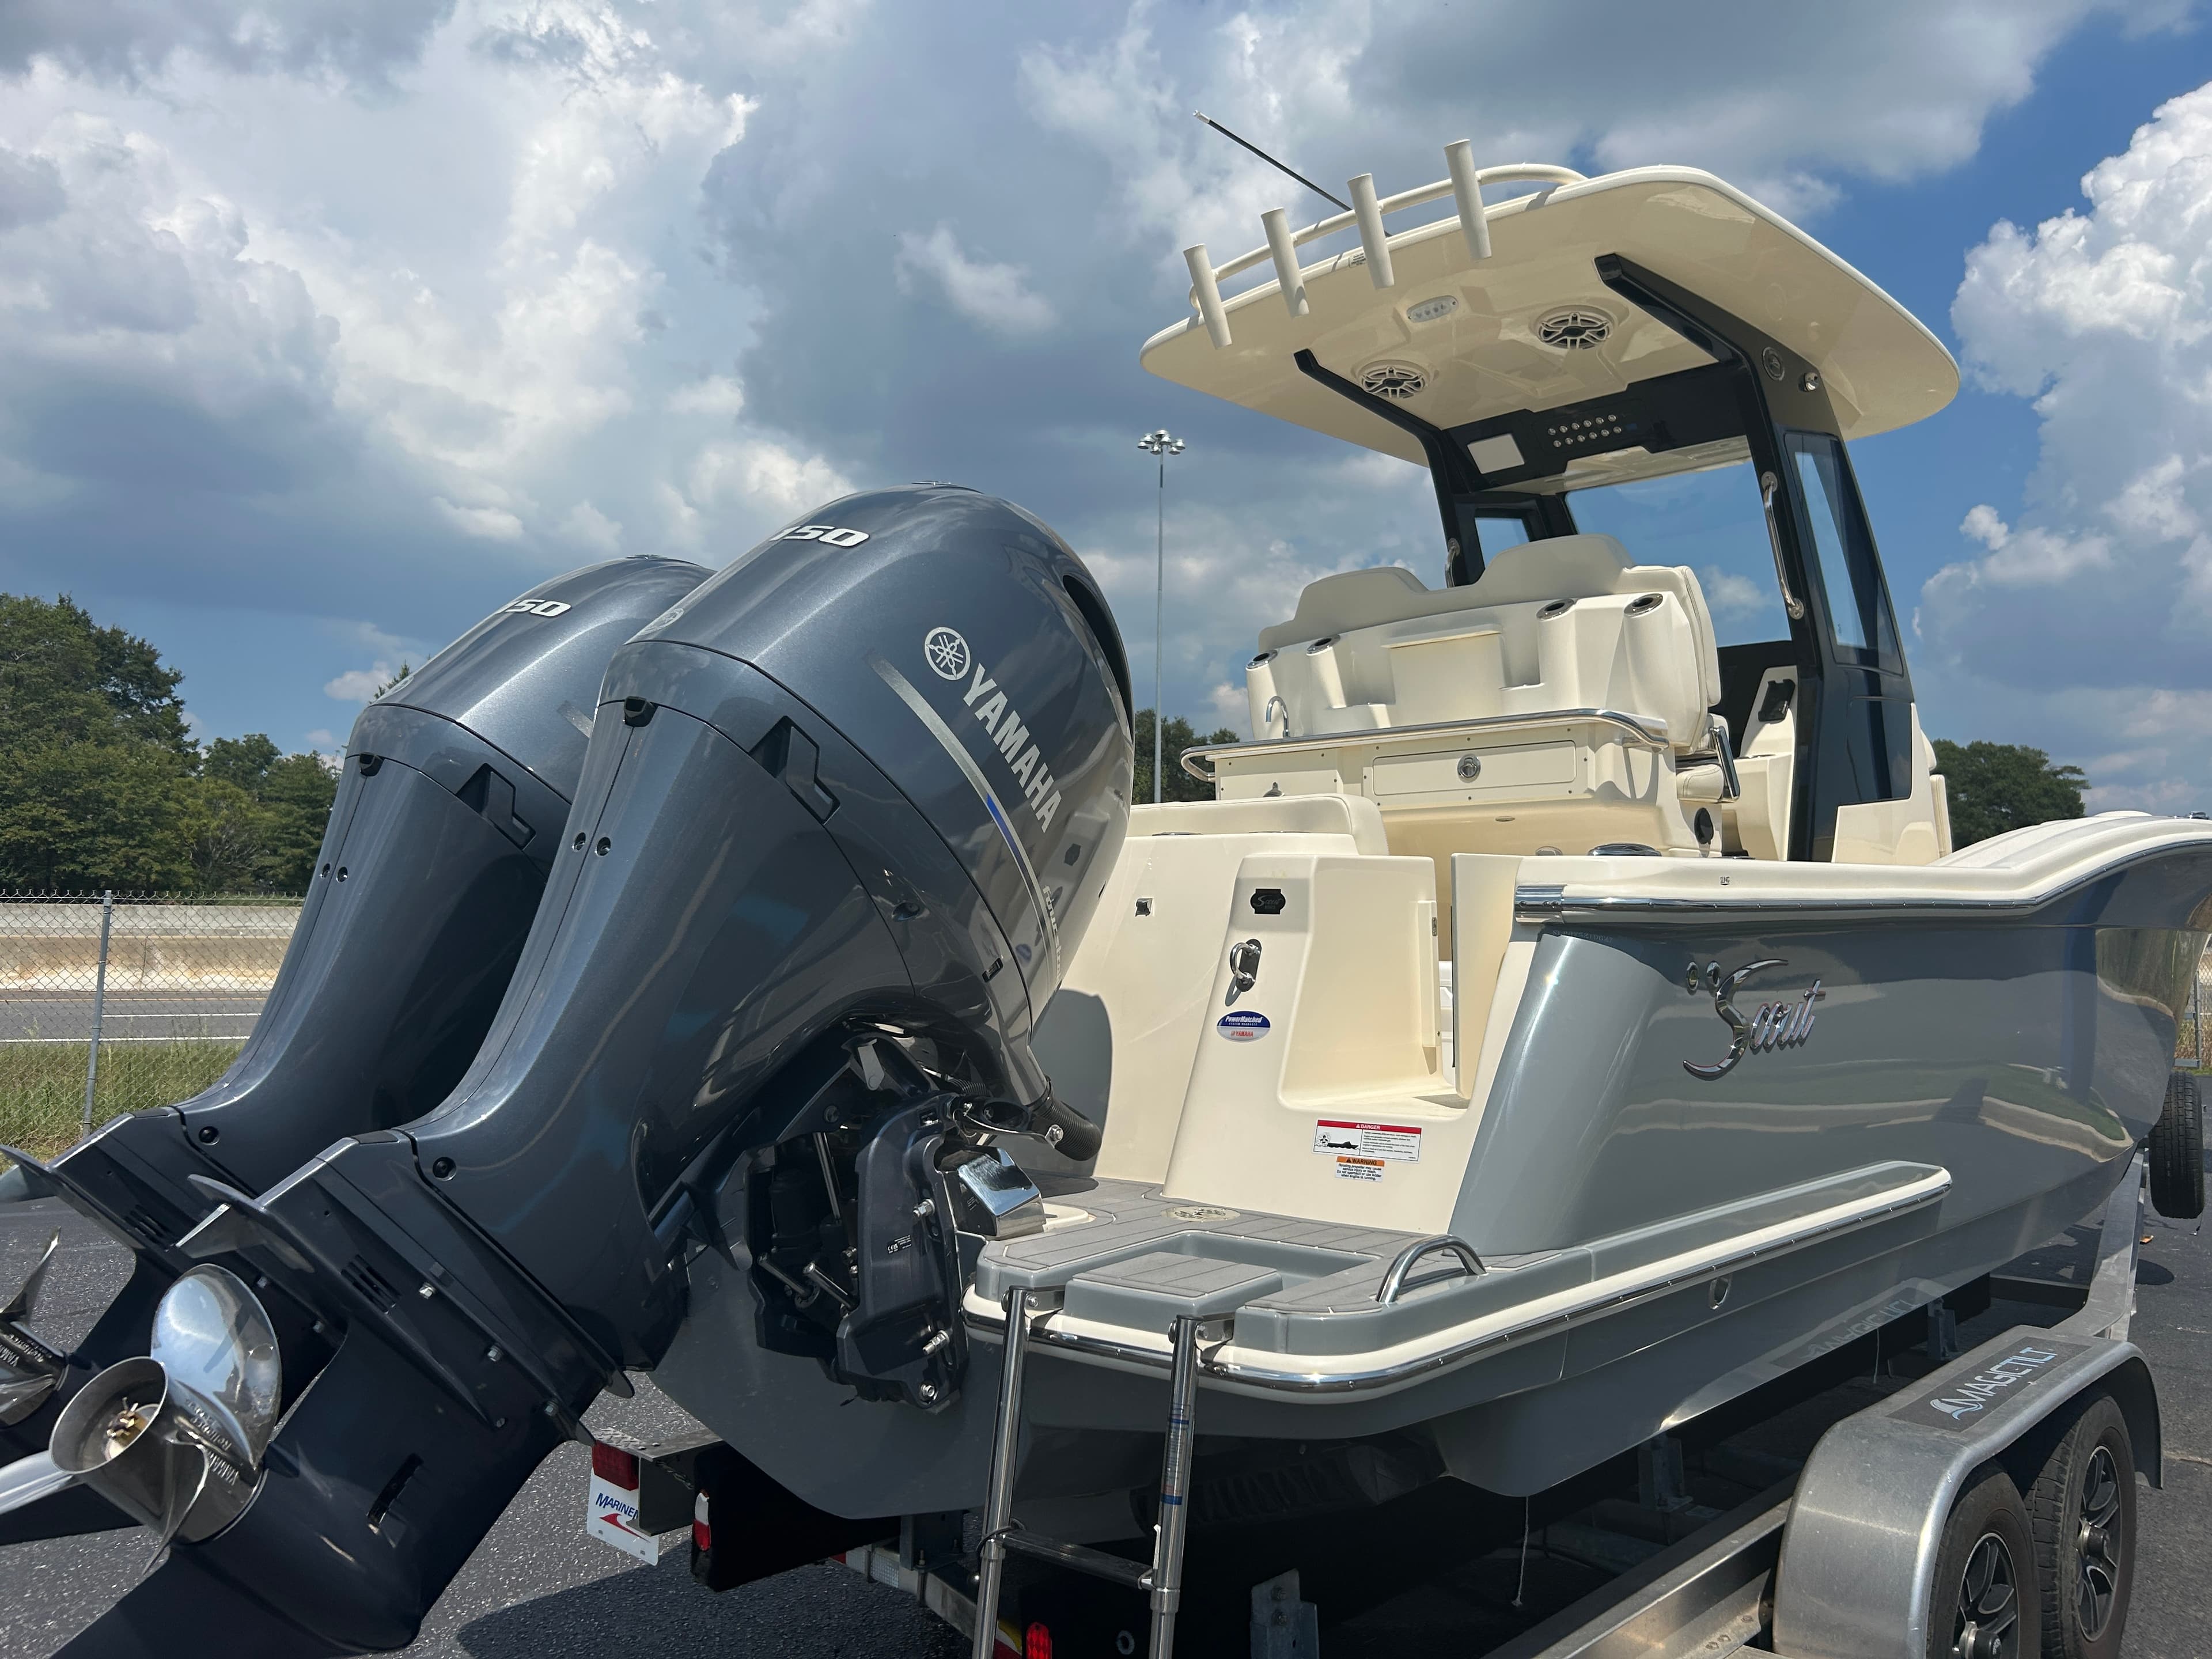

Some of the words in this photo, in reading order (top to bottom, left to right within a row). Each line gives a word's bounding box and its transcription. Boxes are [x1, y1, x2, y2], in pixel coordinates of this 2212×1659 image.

[770, 525, 870, 547] 150
[963, 662, 1062, 834] YAMAHA
[1683, 959, 1826, 1081] Scout
[1941, 1347, 2058, 1409] MAGICTILT
